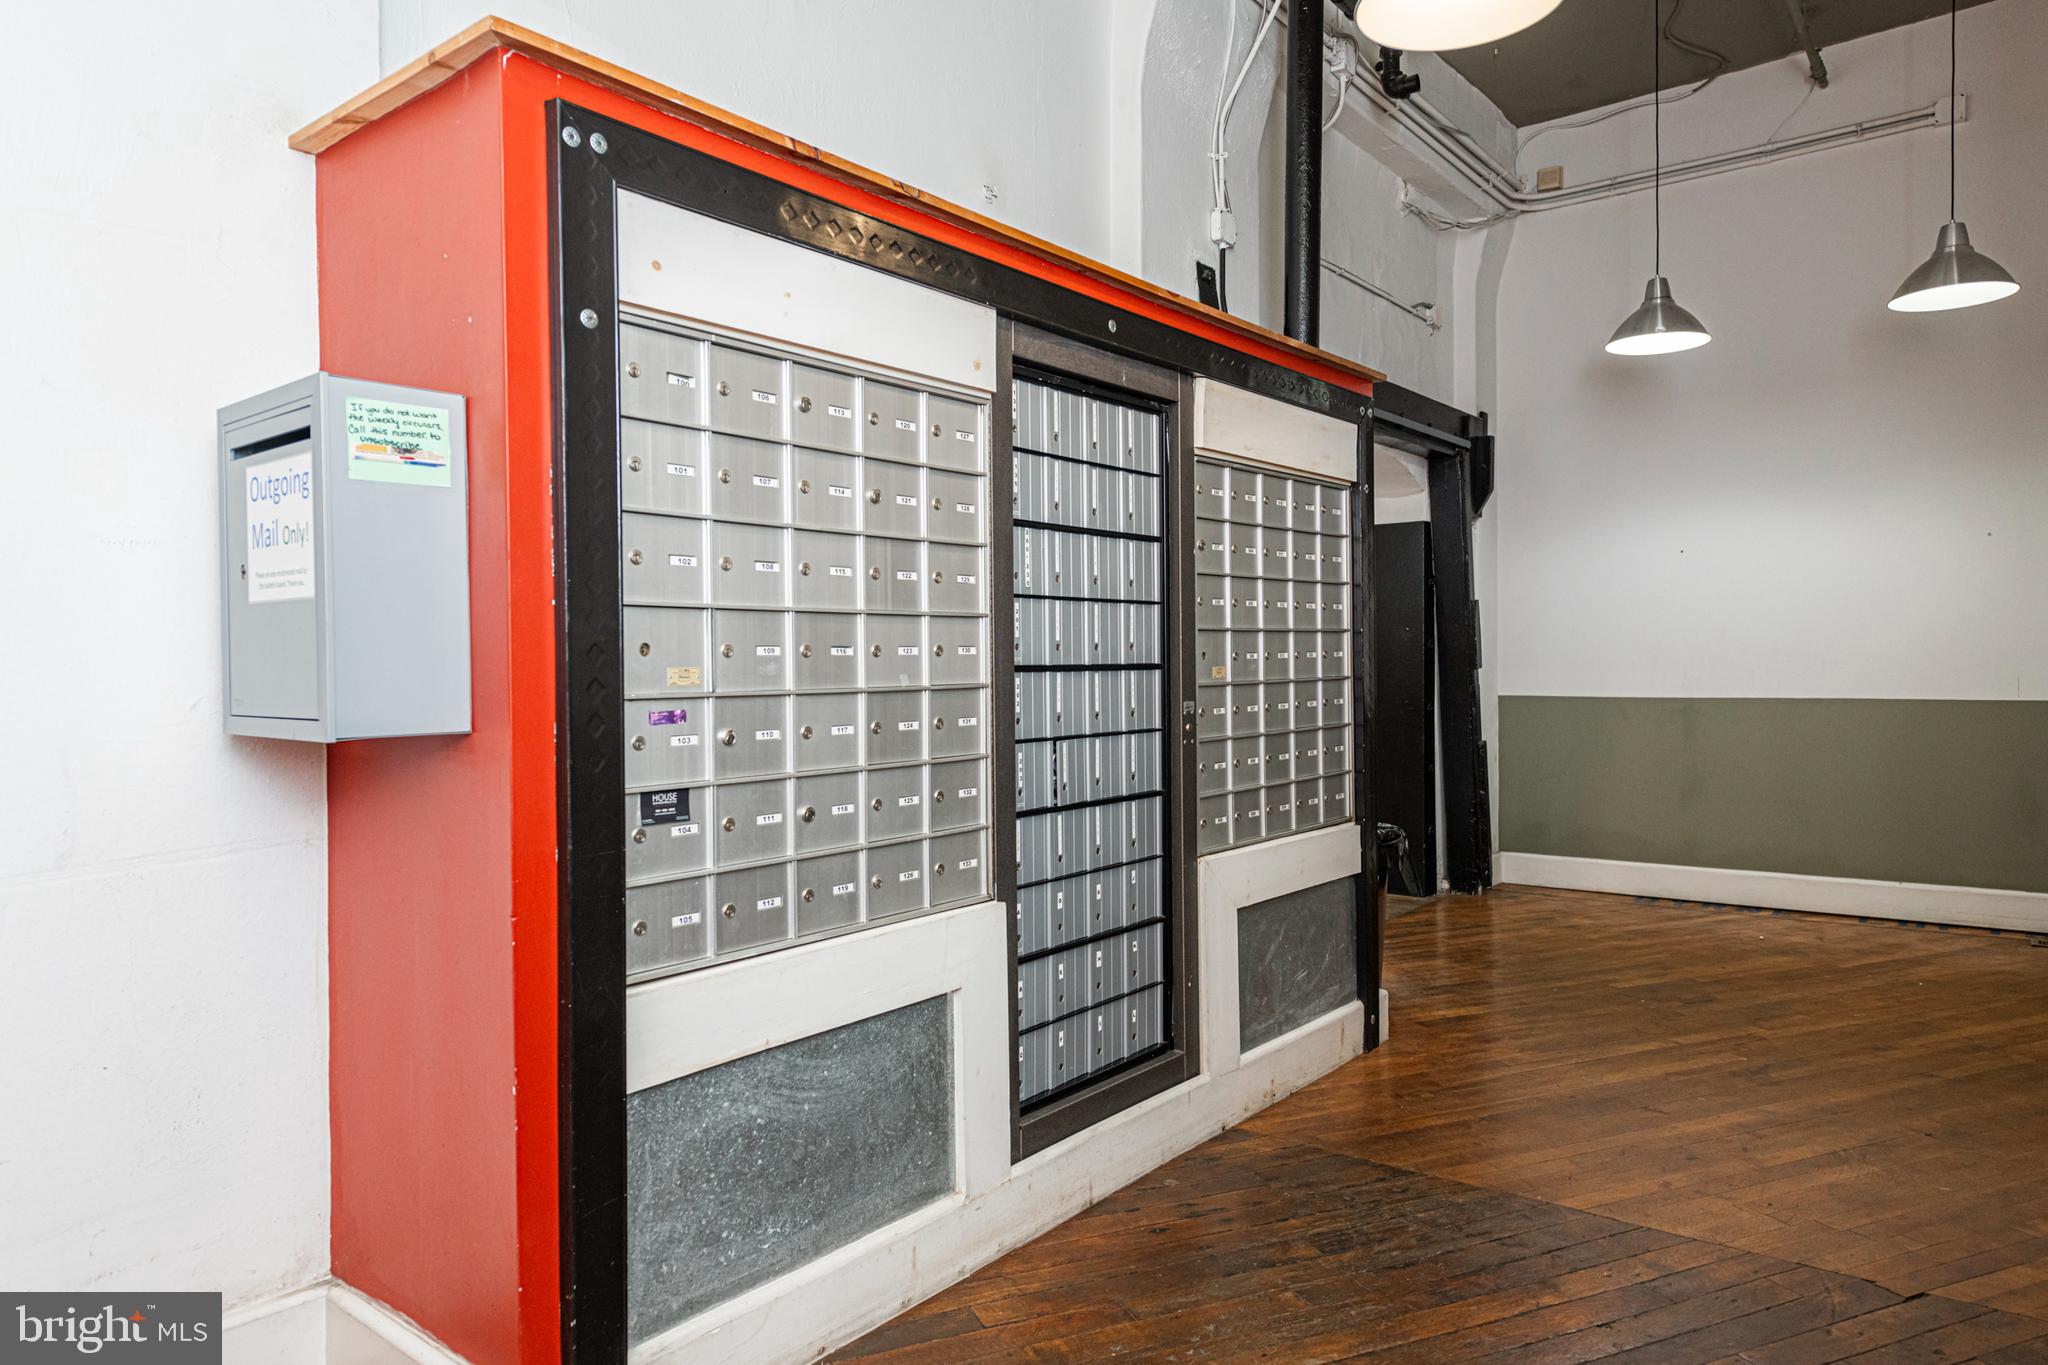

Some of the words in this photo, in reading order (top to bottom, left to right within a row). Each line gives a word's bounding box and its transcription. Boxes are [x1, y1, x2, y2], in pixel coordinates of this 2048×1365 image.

[348, 413, 364, 422] the
[348, 424, 366, 434] Call
[430, 431, 441, 441] to
[250, 468, 310, 504] Outgoing
[252, 518, 278, 550] Mail
[282, 522, 309, 548] Only!
[652, 792, 677, 802] HOUSE
